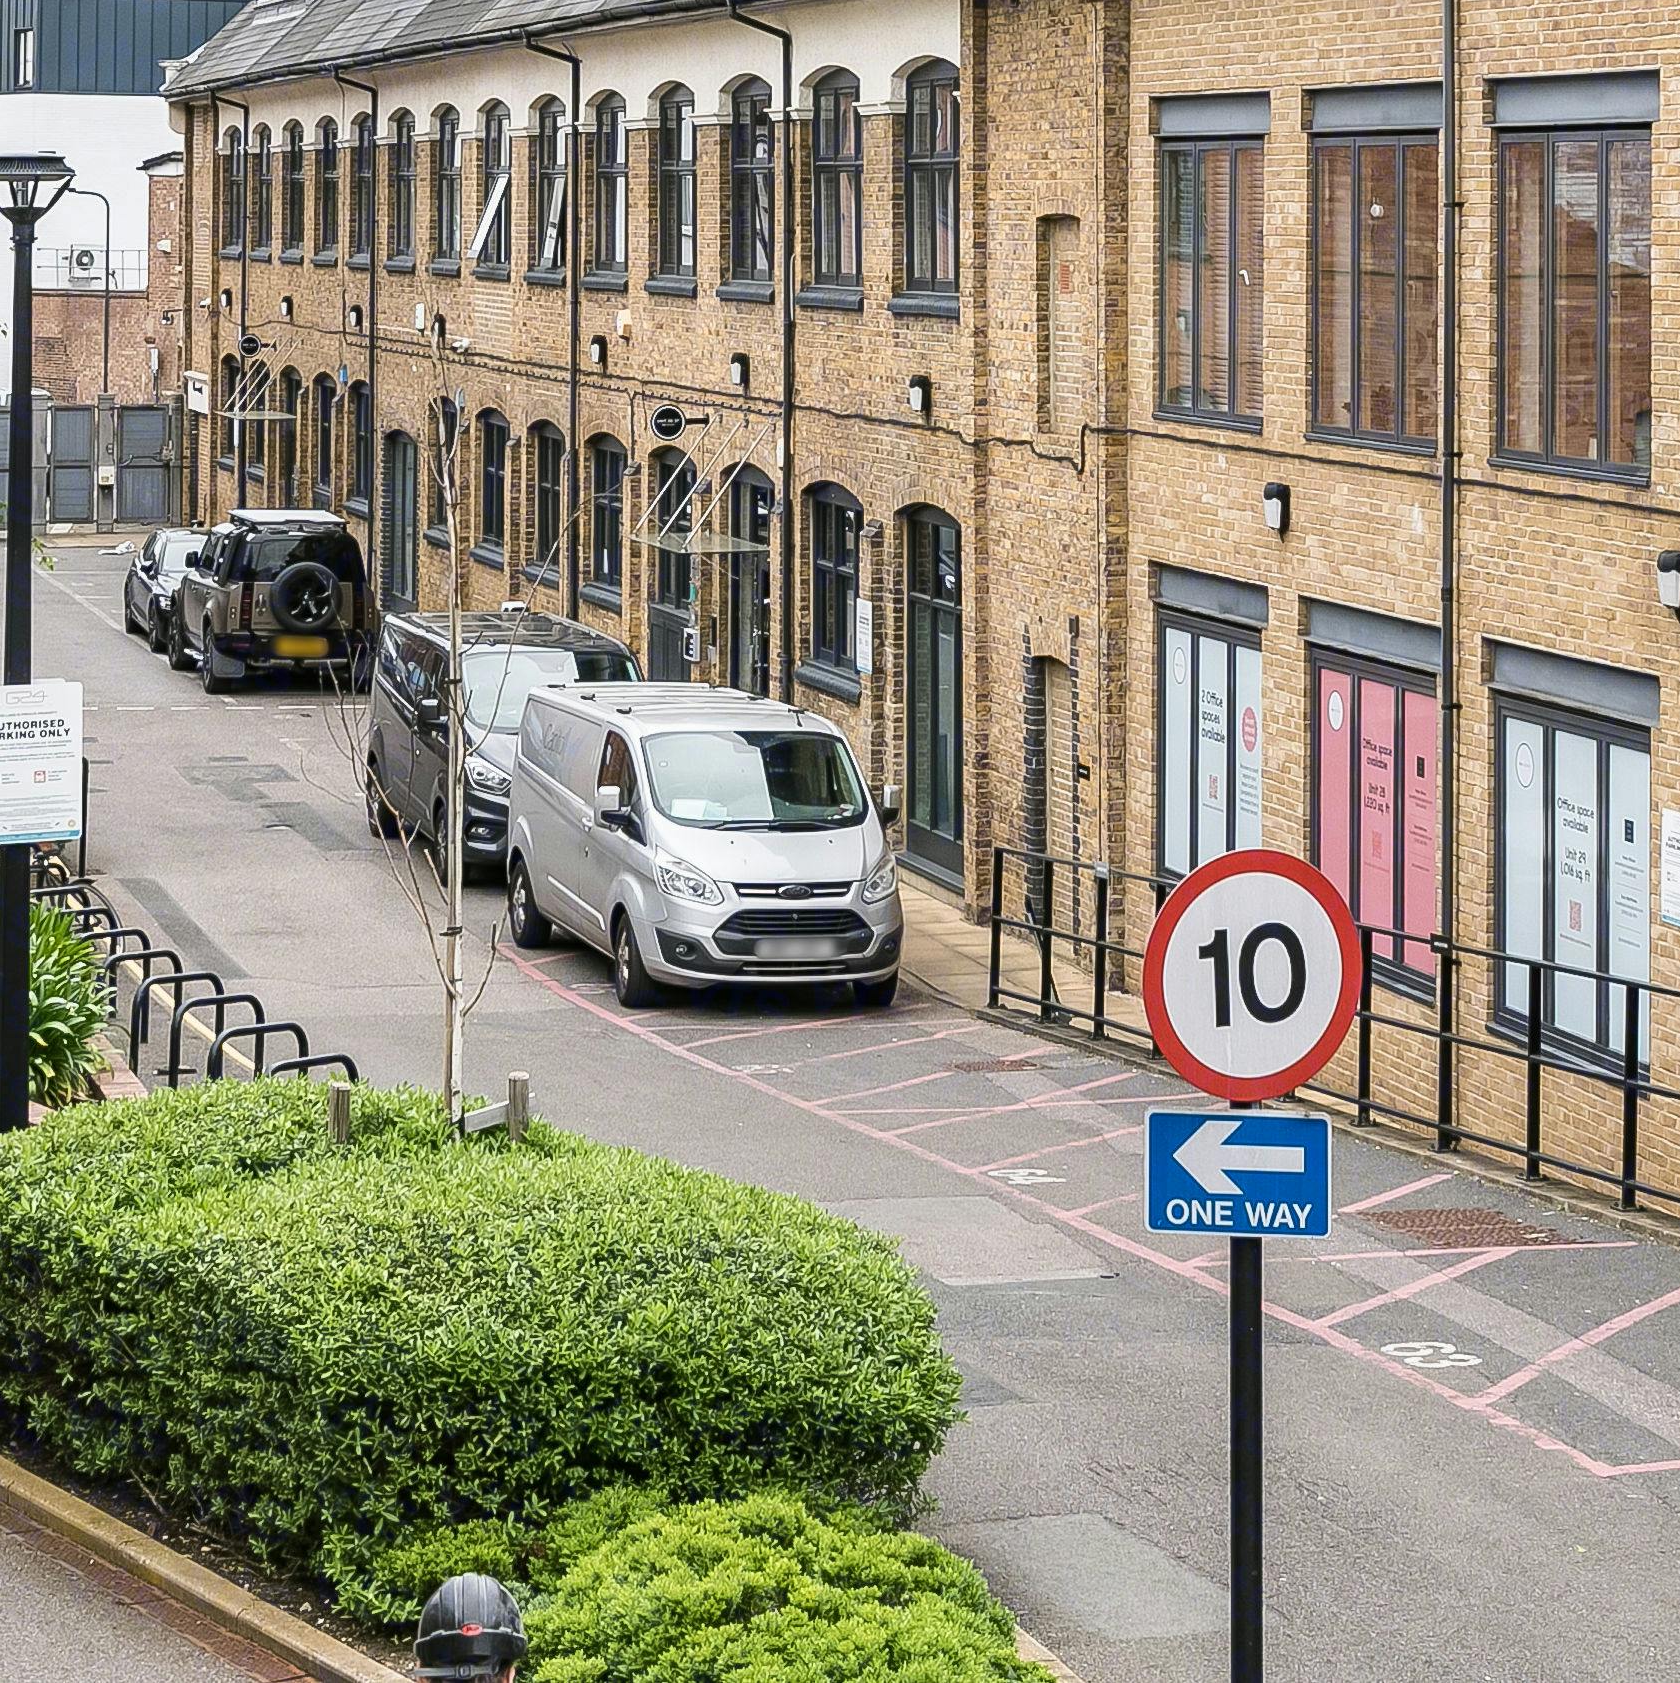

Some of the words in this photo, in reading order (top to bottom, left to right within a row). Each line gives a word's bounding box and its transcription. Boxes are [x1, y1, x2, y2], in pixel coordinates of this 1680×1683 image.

[1206, 691, 1224, 708] Office
[1201, 710, 1221, 725] spaces
[39, 728, 71, 738] ONLY
[1201, 727, 1226, 744] available
[1557, 797, 1576, 814] Office
[1198, 921, 1307, 1028] 10
[987, 1168, 1067, 1185] 64
[1166, 1198, 1234, 1226] ONE
[1244, 1201, 1313, 1229] WAY
[1380, 1341, 1483, 1369] 63
